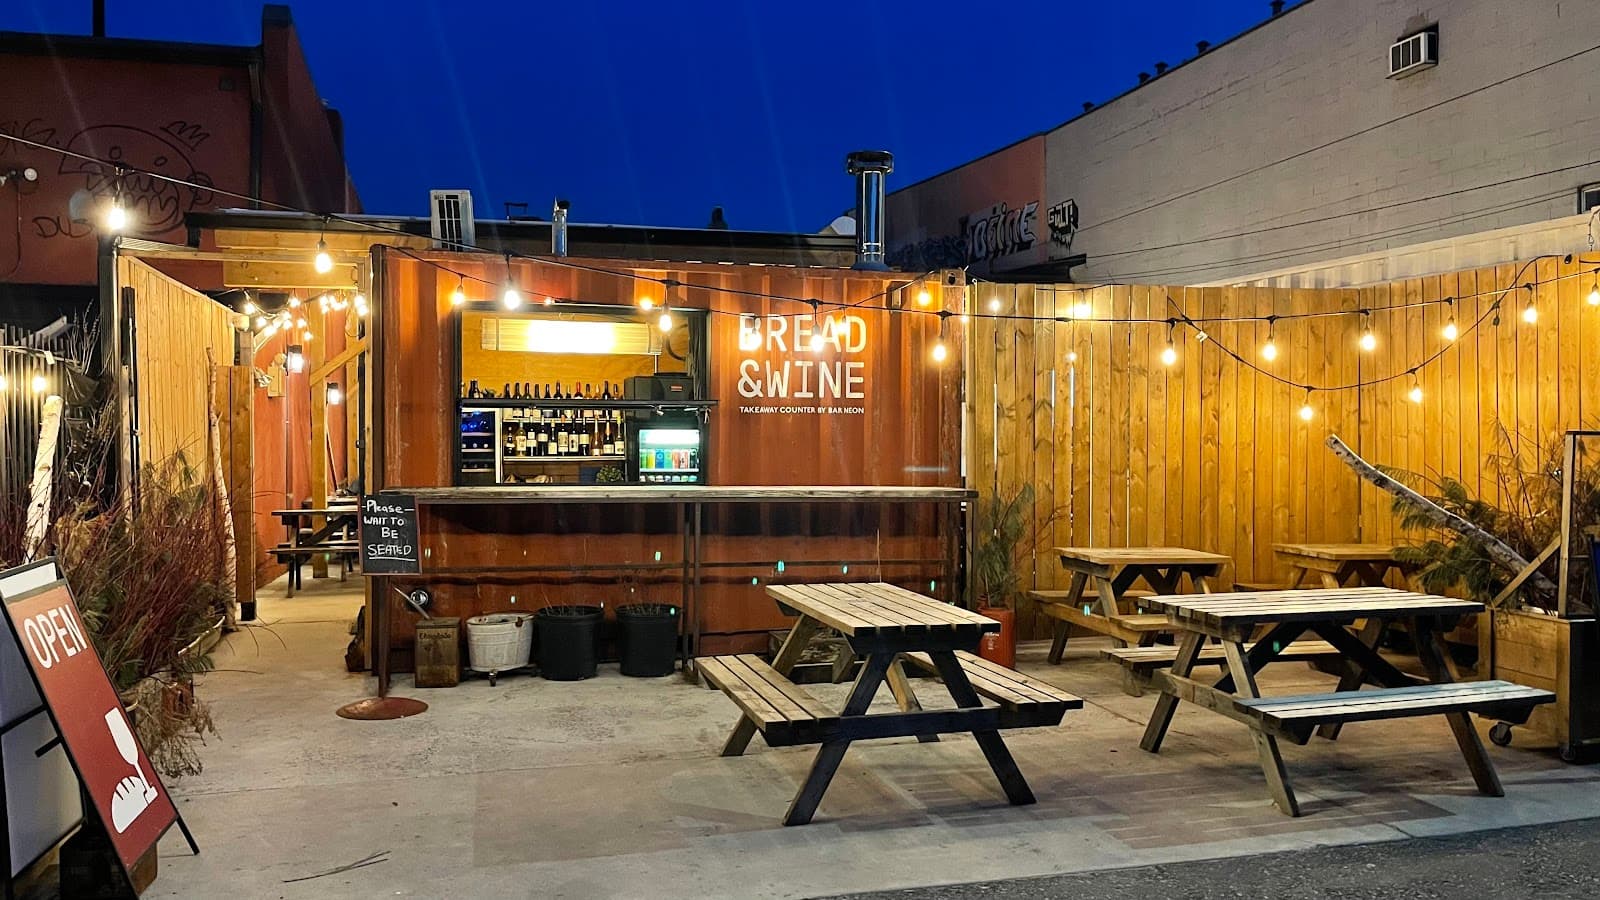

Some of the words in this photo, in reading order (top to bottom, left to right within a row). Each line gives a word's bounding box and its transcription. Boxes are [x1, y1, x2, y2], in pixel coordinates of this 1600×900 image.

[738, 313, 867, 353] BREAD
[738, 359, 865, 399] &WINE
[740, 406, 778, 414] TAKEAWAY
[780, 406, 815, 414] COUNTER
[818, 406, 826, 414] BY
[828, 406, 843, 414] BAR
[844, 406, 864, 414] NEON
[366, 499, 404, 514] Please
[363, 515, 388, 526] WAIT
[391, 516, 404, 526] TO
[381, 526, 399, 539] BE
[367, 543, 412, 556] SEATED
[23, 603, 88, 669] OPEN
